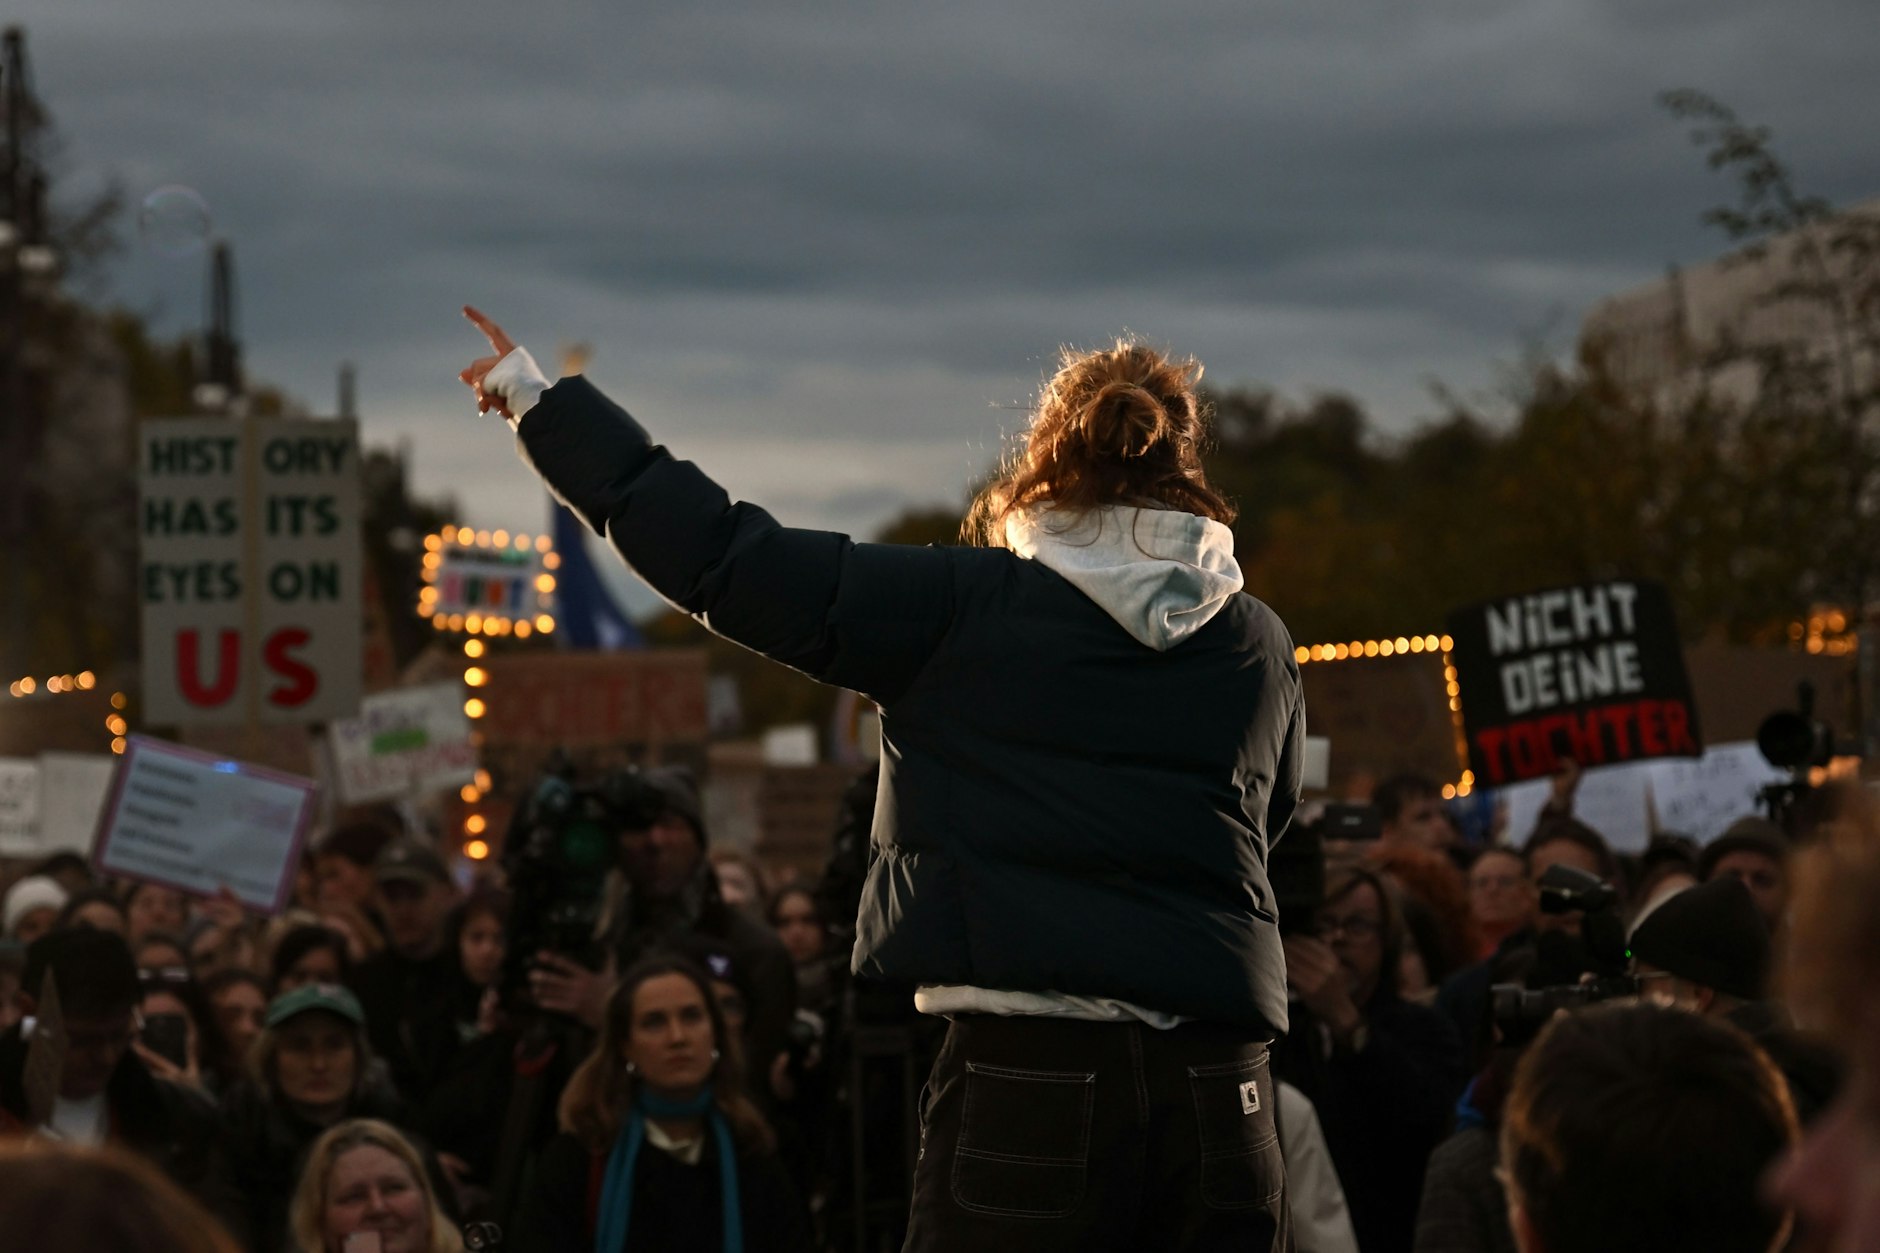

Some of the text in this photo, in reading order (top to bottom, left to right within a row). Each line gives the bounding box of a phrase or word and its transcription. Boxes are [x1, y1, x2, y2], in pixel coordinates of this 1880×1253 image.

[145, 496, 339, 536] HAS ITS
[144, 562, 339, 602] EYES ON
[1477, 699, 1700, 784] TOCHTER
